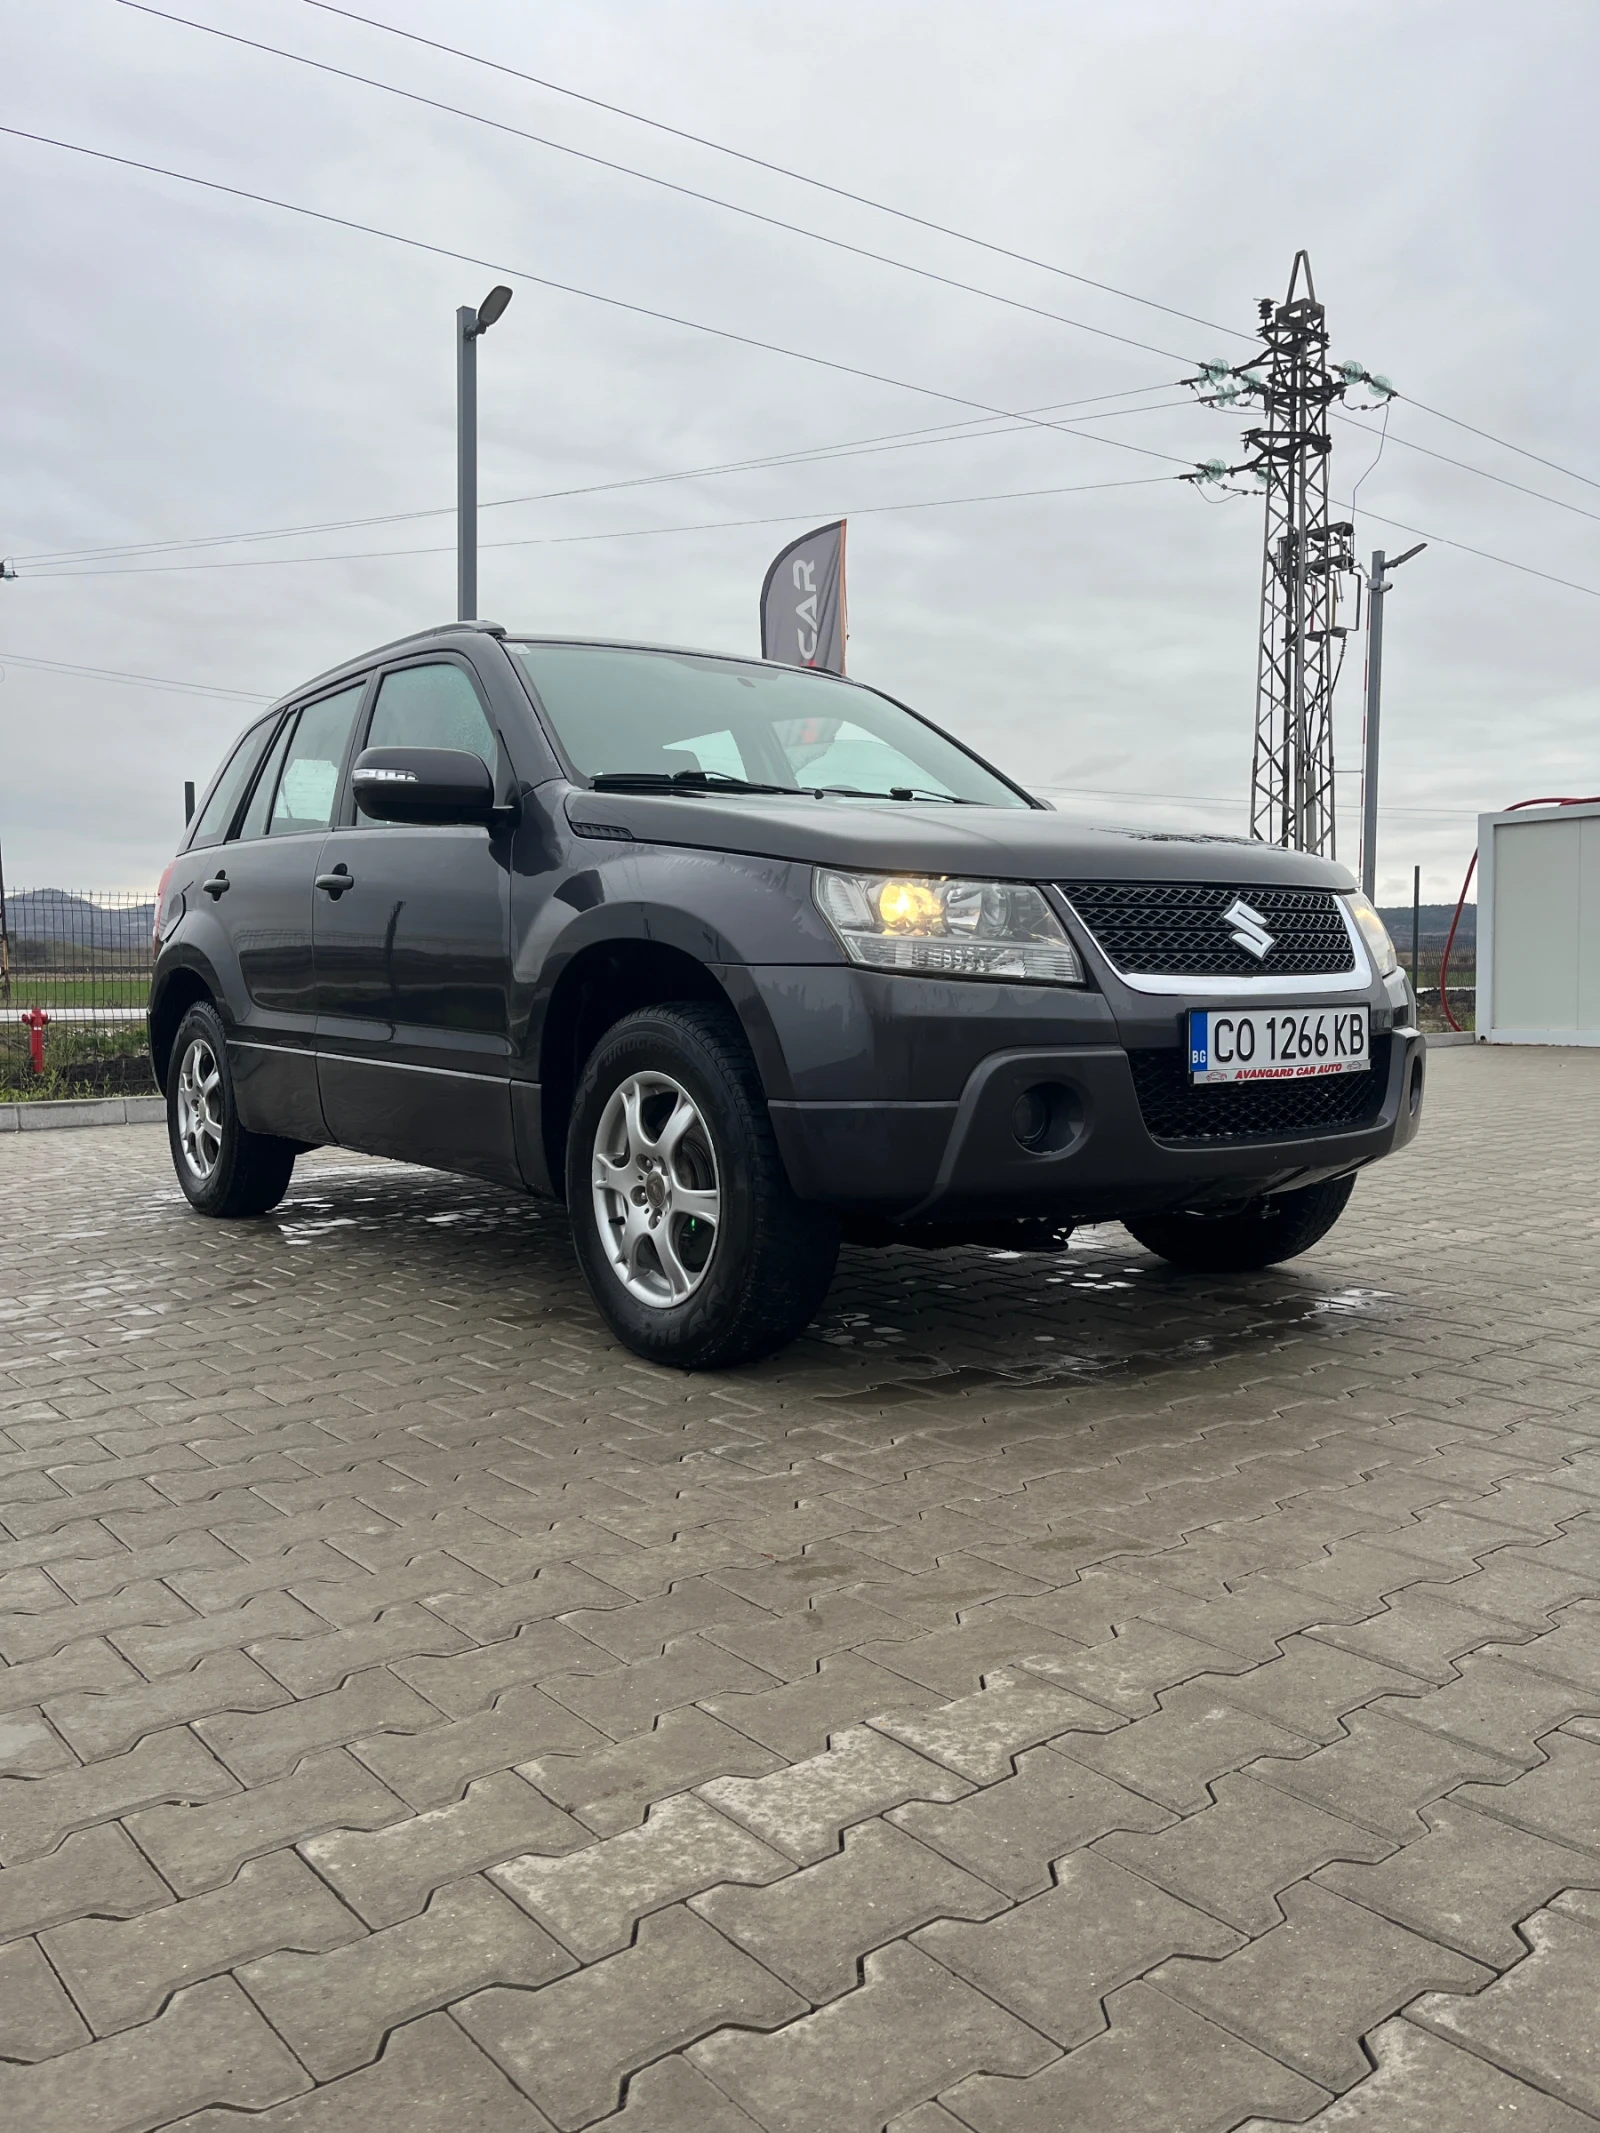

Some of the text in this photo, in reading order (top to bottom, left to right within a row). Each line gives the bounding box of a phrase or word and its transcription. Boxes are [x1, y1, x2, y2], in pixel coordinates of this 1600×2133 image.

[793, 560, 817, 659] CAR
[1214, 1013, 1364, 1063] CO 1266 KB
[1192, 1050, 1207, 1064] BG
[1234, 1063, 1342, 1080] AVANGARD CAR AUTO
